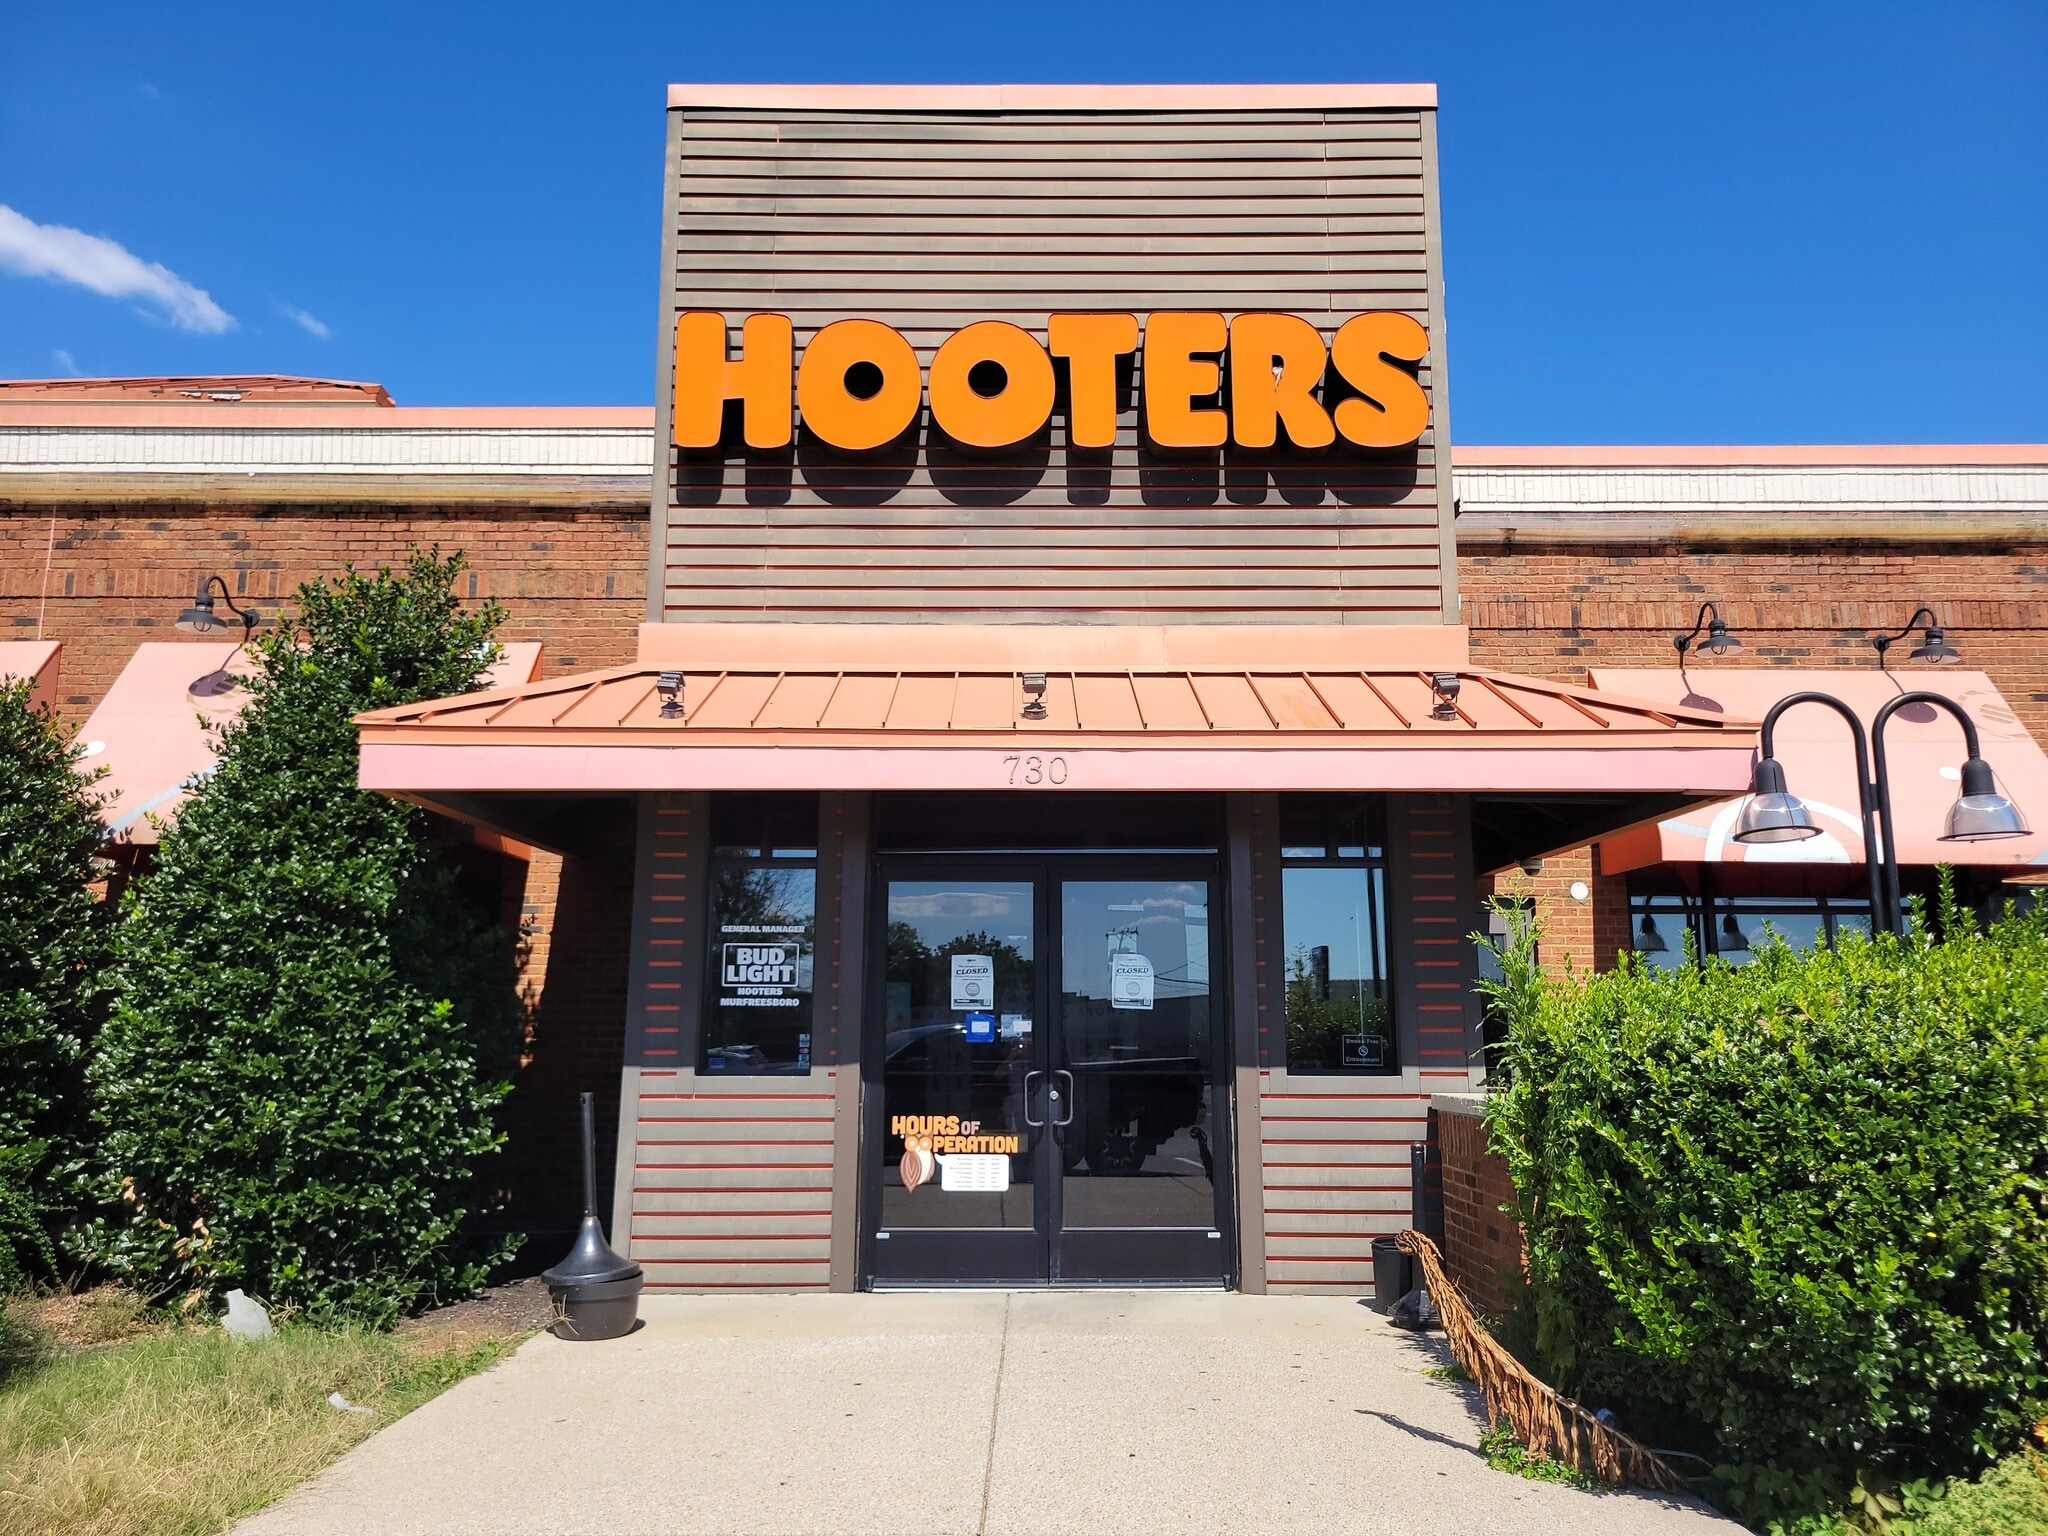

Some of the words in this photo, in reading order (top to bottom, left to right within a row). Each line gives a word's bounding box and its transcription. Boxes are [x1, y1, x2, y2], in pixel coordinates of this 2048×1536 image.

[674, 311, 1430, 450] HOOTERS
[1003, 755, 1068, 785] 730
[721, 925, 761, 933] GENERAL
[762, 925, 805, 933] MANAGER
[737, 948, 785, 965] BUD
[727, 965, 794, 982] LIGHT
[956, 967, 989, 975] CLOSED
[737, 987, 784, 996] HOOTERS
[720, 998, 800, 1007] MURFREESBORO
[891, 1115, 960, 1135] HOURS
[961, 1121, 981, 1135] OF
